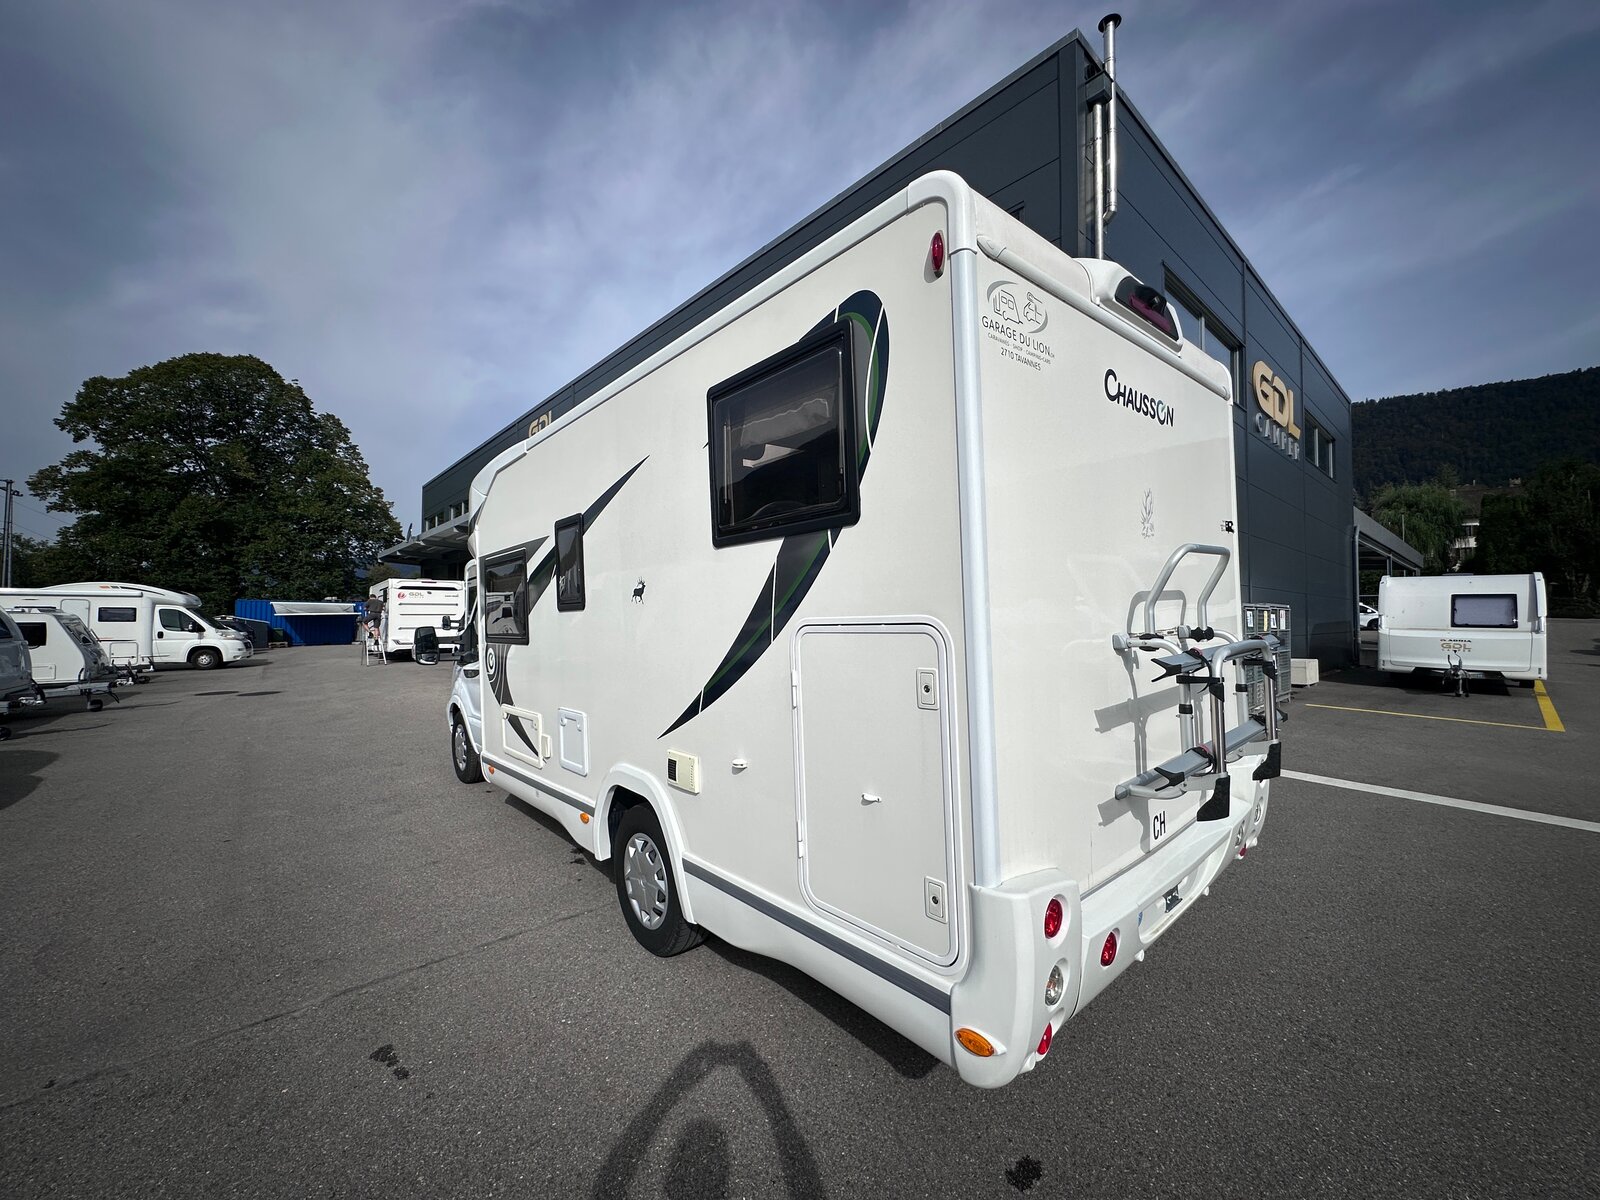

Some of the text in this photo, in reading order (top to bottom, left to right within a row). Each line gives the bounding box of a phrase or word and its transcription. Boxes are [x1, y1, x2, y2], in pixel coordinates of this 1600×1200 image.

[981, 315, 1018, 342] GARAGE
[1019, 332, 1031, 347] DU
[1032, 338, 1051, 356] LION
[1000, 346, 1042, 372] 2710 TAVANNES
[1104, 368, 1175, 427] CHAUSSON
[1252, 360, 1301, 440] GDL
[1255, 412, 1300, 461] CAMPER
[1153, 810, 1166, 840] CH
